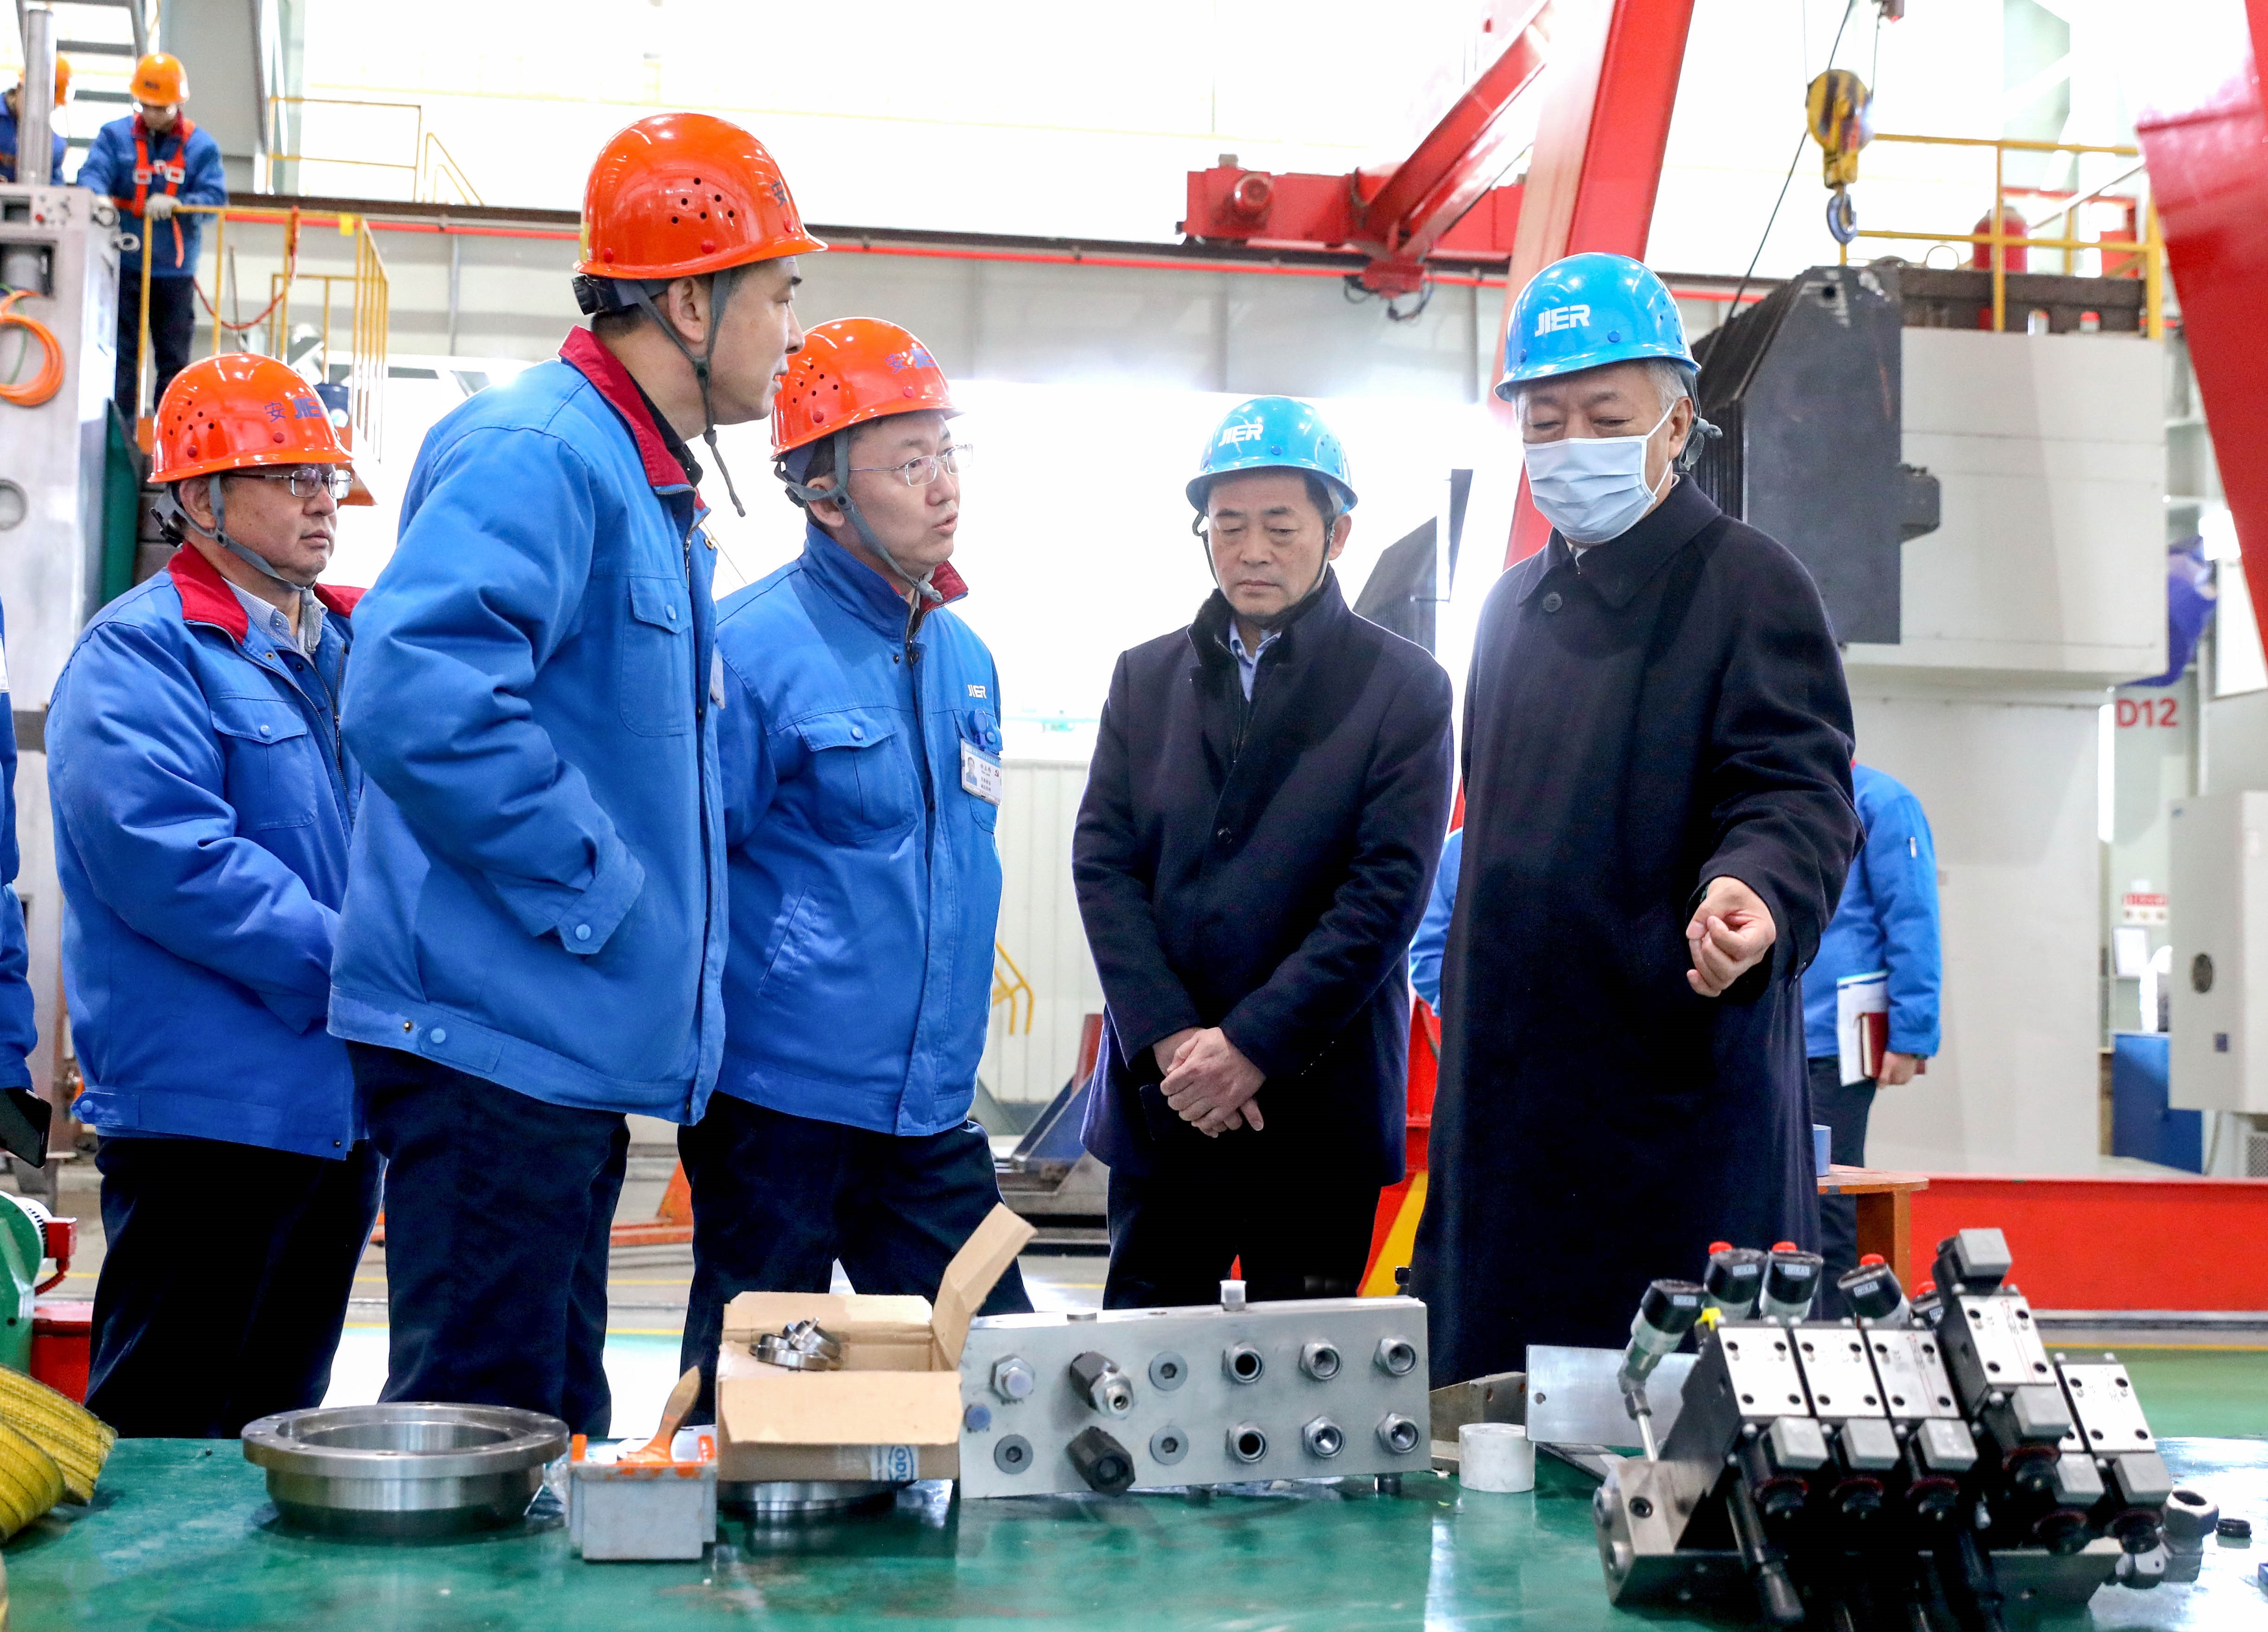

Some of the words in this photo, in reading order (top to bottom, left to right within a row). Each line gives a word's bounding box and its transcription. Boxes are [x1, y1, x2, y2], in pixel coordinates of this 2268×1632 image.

[1535, 304, 1590, 337] JIER
[884, 353, 907, 373] 安
[264, 401, 286, 422] 安
[1218, 424, 1264, 447] JIER
[967, 684, 987, 699] JIER
[2117, 698, 2178, 728] D12
